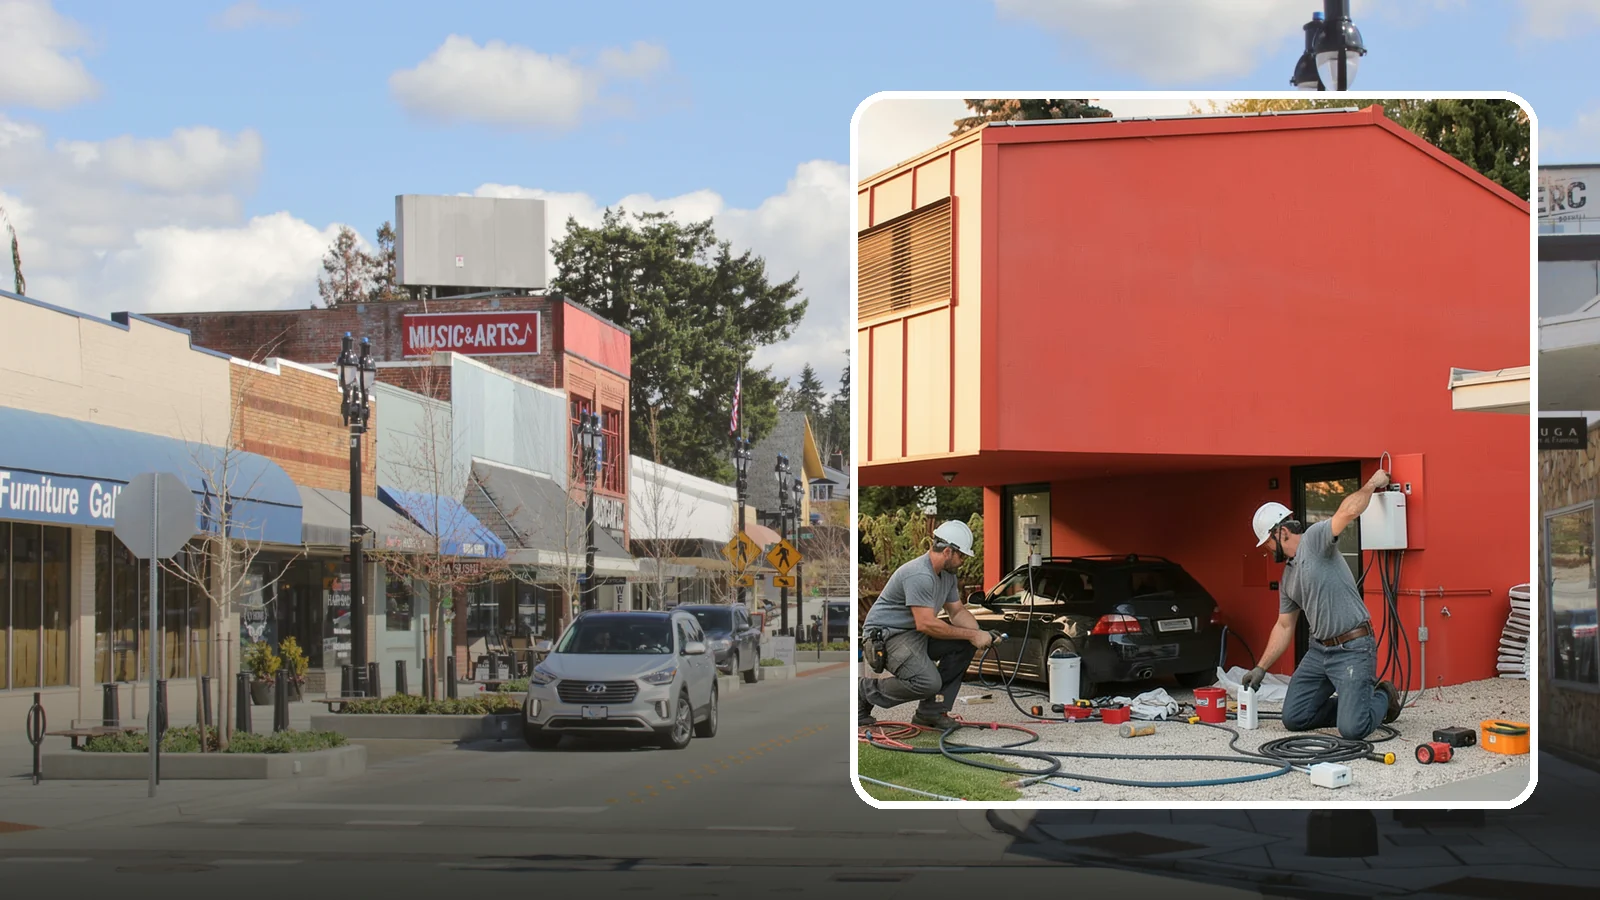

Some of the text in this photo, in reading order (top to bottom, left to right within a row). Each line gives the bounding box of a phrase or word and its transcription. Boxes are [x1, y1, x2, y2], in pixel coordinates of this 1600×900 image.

[408, 322, 520, 350] MUSIC&ARTS
[0, 471, 122, 519] Furniture Gal
